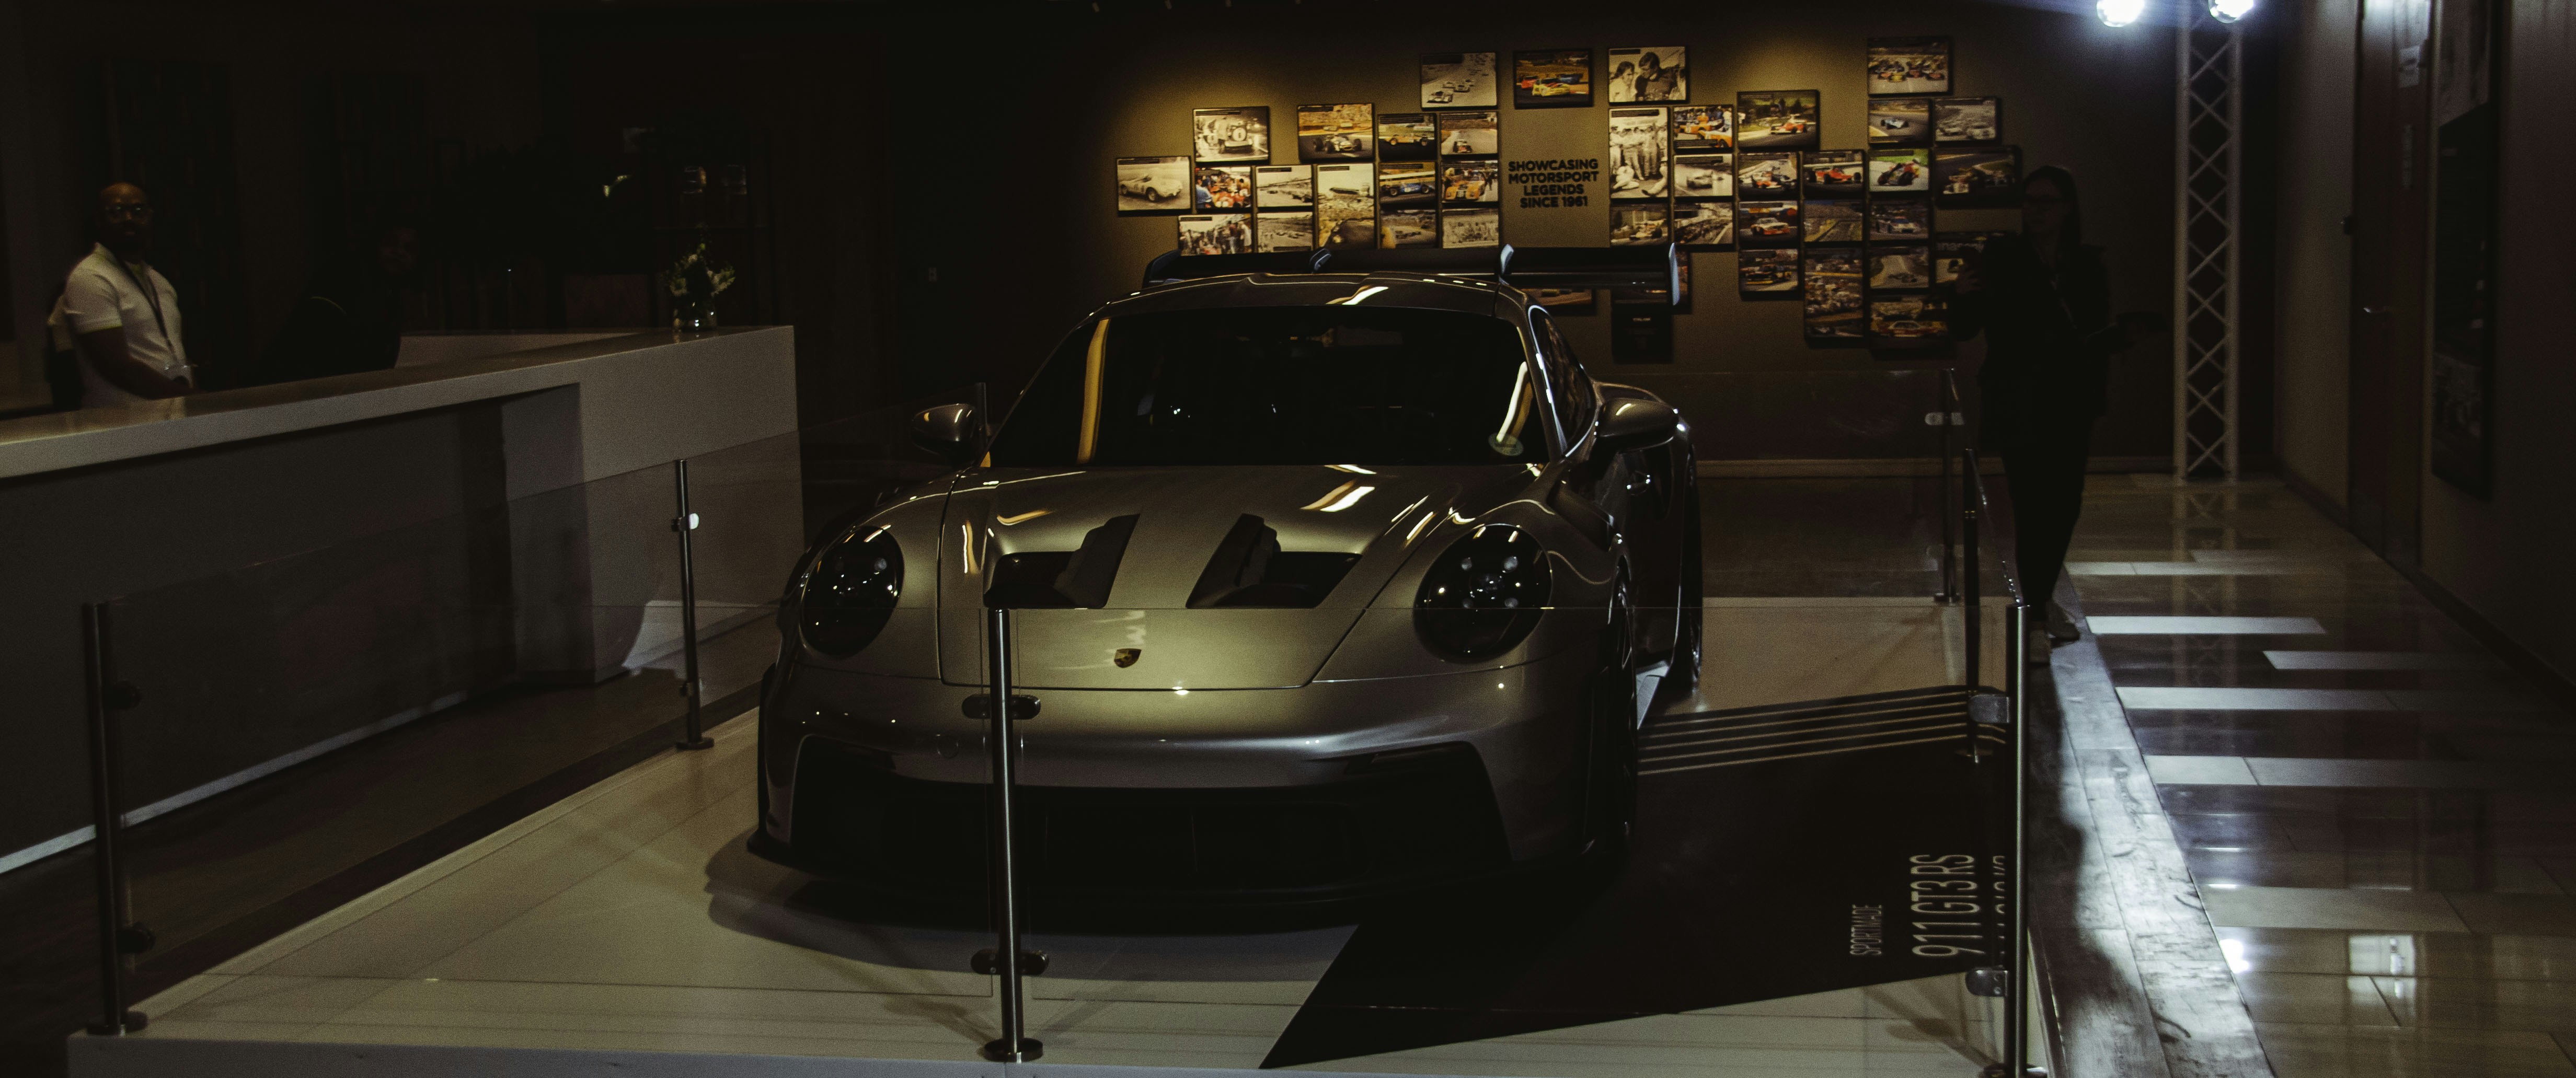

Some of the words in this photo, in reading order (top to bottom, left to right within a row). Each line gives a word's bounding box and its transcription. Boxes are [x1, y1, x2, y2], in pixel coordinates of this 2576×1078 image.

[1509, 158, 1598, 171] SHOWCASING
[1509, 171, 1598, 183] MOTORSPORT
[1524, 184, 1583, 196] LEGENDS
[1520, 196, 1558, 208] SINCE
[1908, 854, 1975, 875] RS
[1910, 880, 1981, 914] GT3
[1850, 905, 1882, 956] SPORTMADE
[1912, 921, 1985, 957] 911
